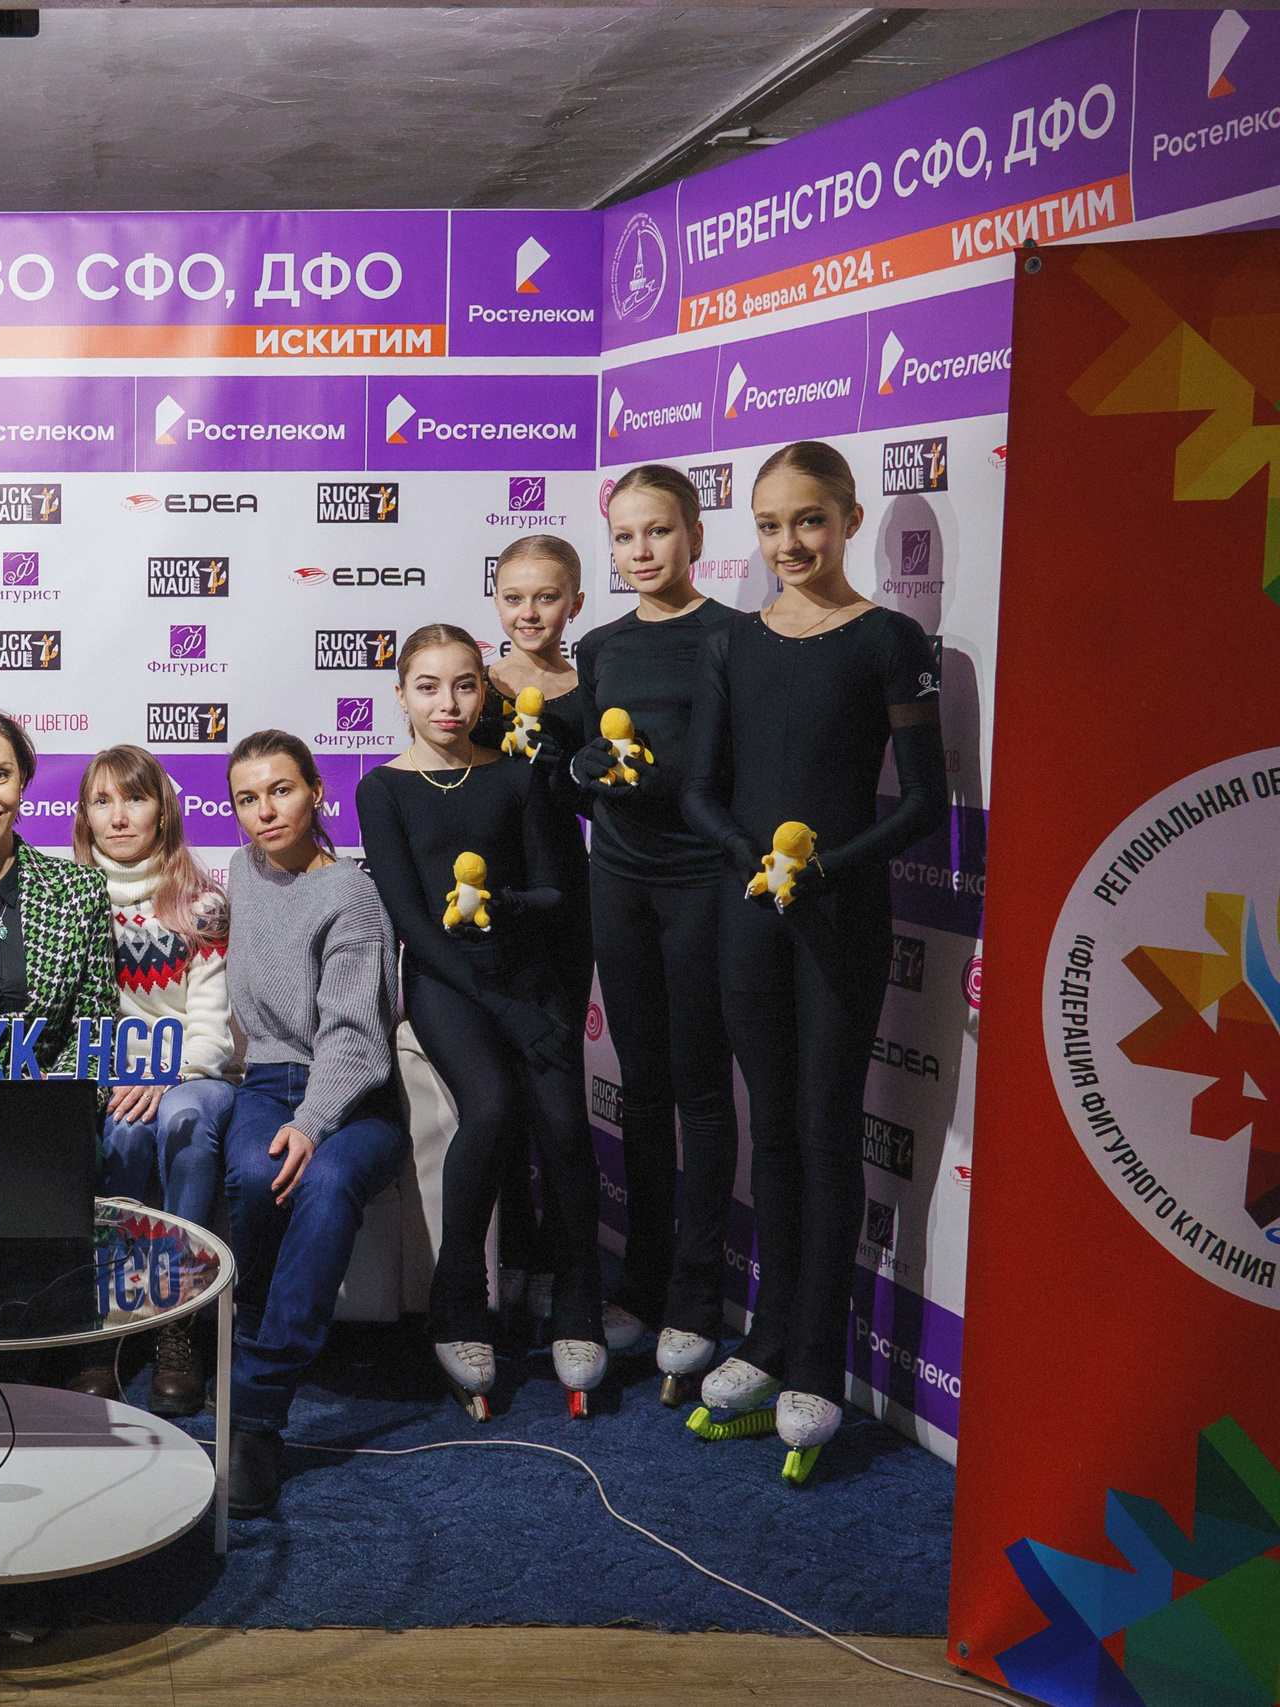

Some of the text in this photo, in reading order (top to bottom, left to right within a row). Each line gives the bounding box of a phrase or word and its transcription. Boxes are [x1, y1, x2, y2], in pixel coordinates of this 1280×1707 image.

[1152, 105, 1280, 162] Ростелеко
[685, 161, 882, 266] ПЕРВЕНСТВО
[893, 126, 992, 198] СФО,
[1004, 83, 1116, 173] ДФО
[950, 183, 1116, 263] ИСКИТИМ
[76, 252, 236, 310] СФО,
[253, 251, 403, 308] ДФО
[688, 251, 894, 329] 17-18 февраля 2024 г.
[468, 304, 595, 323] Ростелеком
[255, 329, 432, 354] ИСКИТИМ
[902, 347, 1012, 387] Ростелеко
[744, 373, 851, 414] Ростелеком
[623, 400, 702, 432] Ростелеком
[186, 418, 346, 441] Ростелеком
[418, 418, 577, 441] Ростелеком
[884, 444, 924, 469] RUCK
[884, 467, 924, 491] MAUL
[164, 494, 258, 513] EDEA
[319, 485, 370, 503] RUCK
[700, 488, 717, 508] AUL
[319, 503, 370, 521] MAUL
[485, 513, 567, 529] Фигурист
[150, 560, 199, 577] RUCK
[332, 567, 426, 587] EDEA
[697, 559, 749, 581] МИР ЦВЕТОВ
[150, 577, 200, 595] MAUL
[882, 577, 945, 599] Фигурист
[317, 632, 367, 650] RUCK
[147, 660, 228, 676] Фигурист
[317, 650, 367, 668] MAUL
[34, 714, 88, 733] ЦВЕТОВ
[149, 706, 199, 723] RUCK
[149, 723, 199, 740] MAUL
[314, 733, 395, 749] Фигурист
[1093, 777, 1250, 907] РЕГИОНАЛЬНАЯ
[890, 858, 986, 897] остелеко
[593, 1078, 618, 1105] RUCK
[864, 1116, 892, 1147] UCK
[1081, 1091, 1177, 1220] ФИГУРНОГО
[1170, 1209, 1277, 1289] КАТАНИЯ
[858, 1241, 910, 1277] игурист
[855, 1316, 961, 1399] Ростелеко
